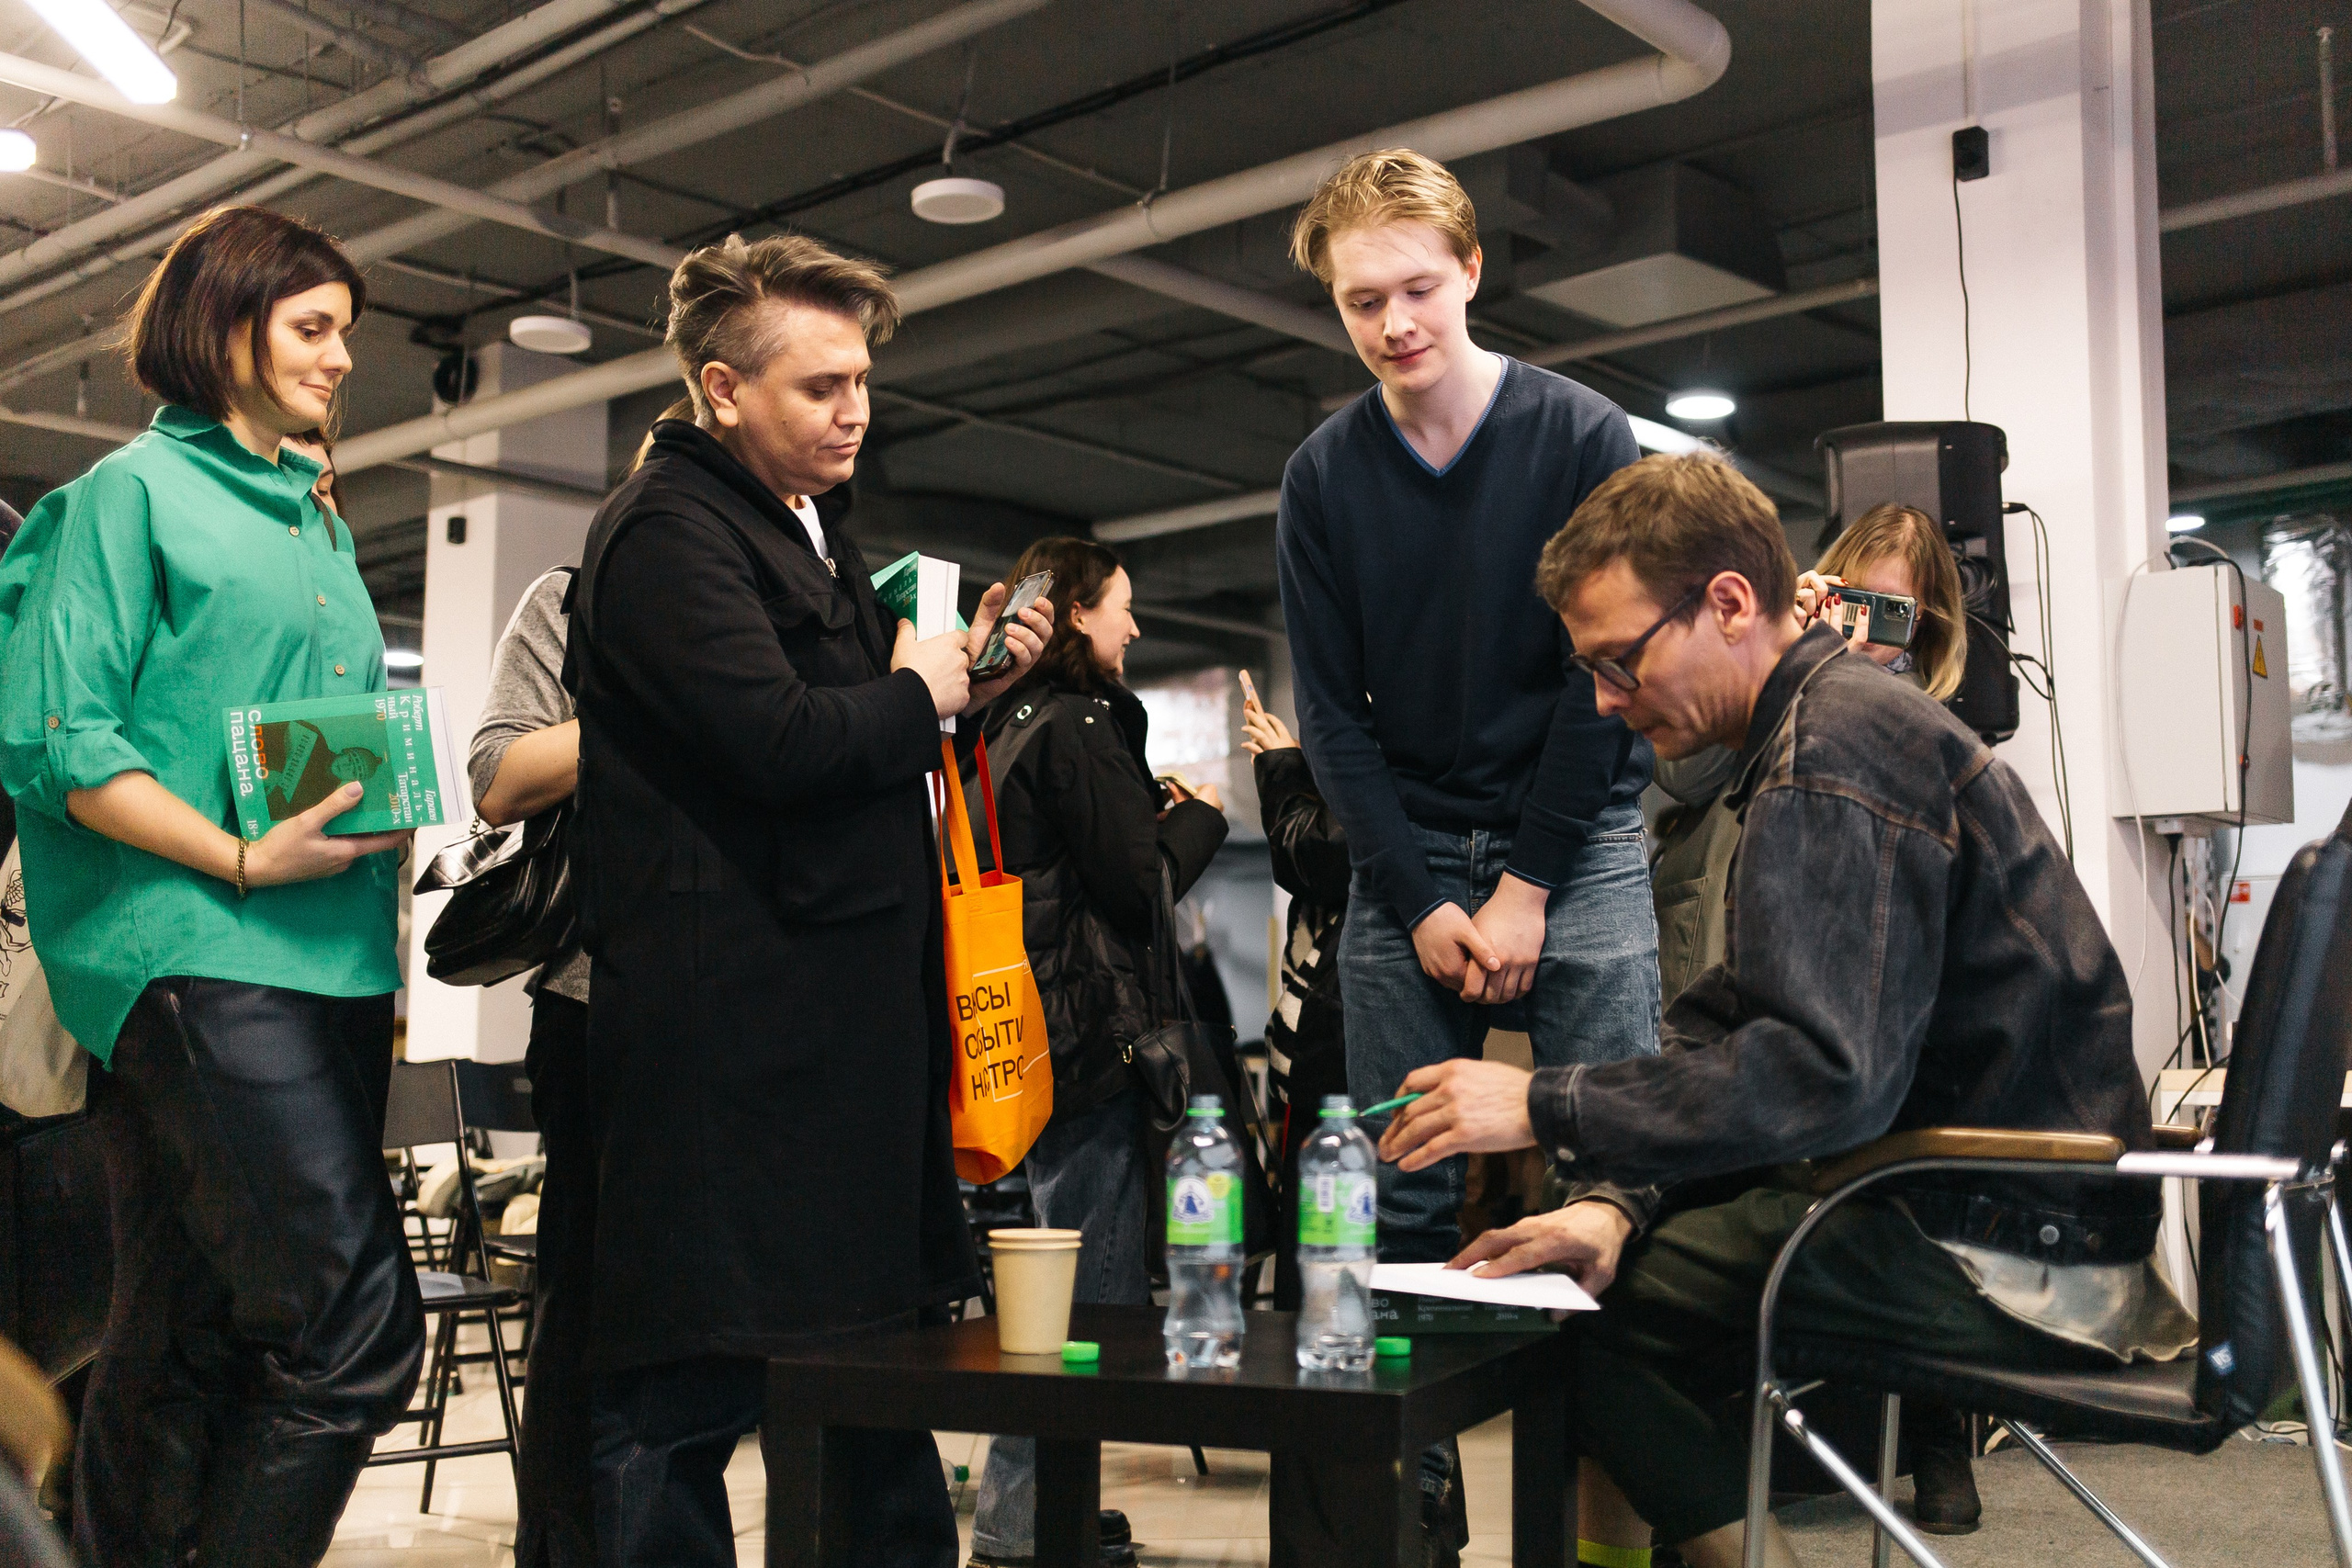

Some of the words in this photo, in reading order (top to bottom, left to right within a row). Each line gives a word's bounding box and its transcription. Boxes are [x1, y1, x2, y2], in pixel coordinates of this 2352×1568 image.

[231, 711, 254, 797] пацана
[247, 708, 269, 780] слово
[375, 698, 386, 722] 1970
[388, 792, 401, 825] 2010-х
[387, 696, 396, 719] ный
[398, 772, 413, 824] Татарстан
[412, 694, 424, 731] Роберт
[424, 789, 437, 821] Гараев
[246, 819, 258, 838] 18+
